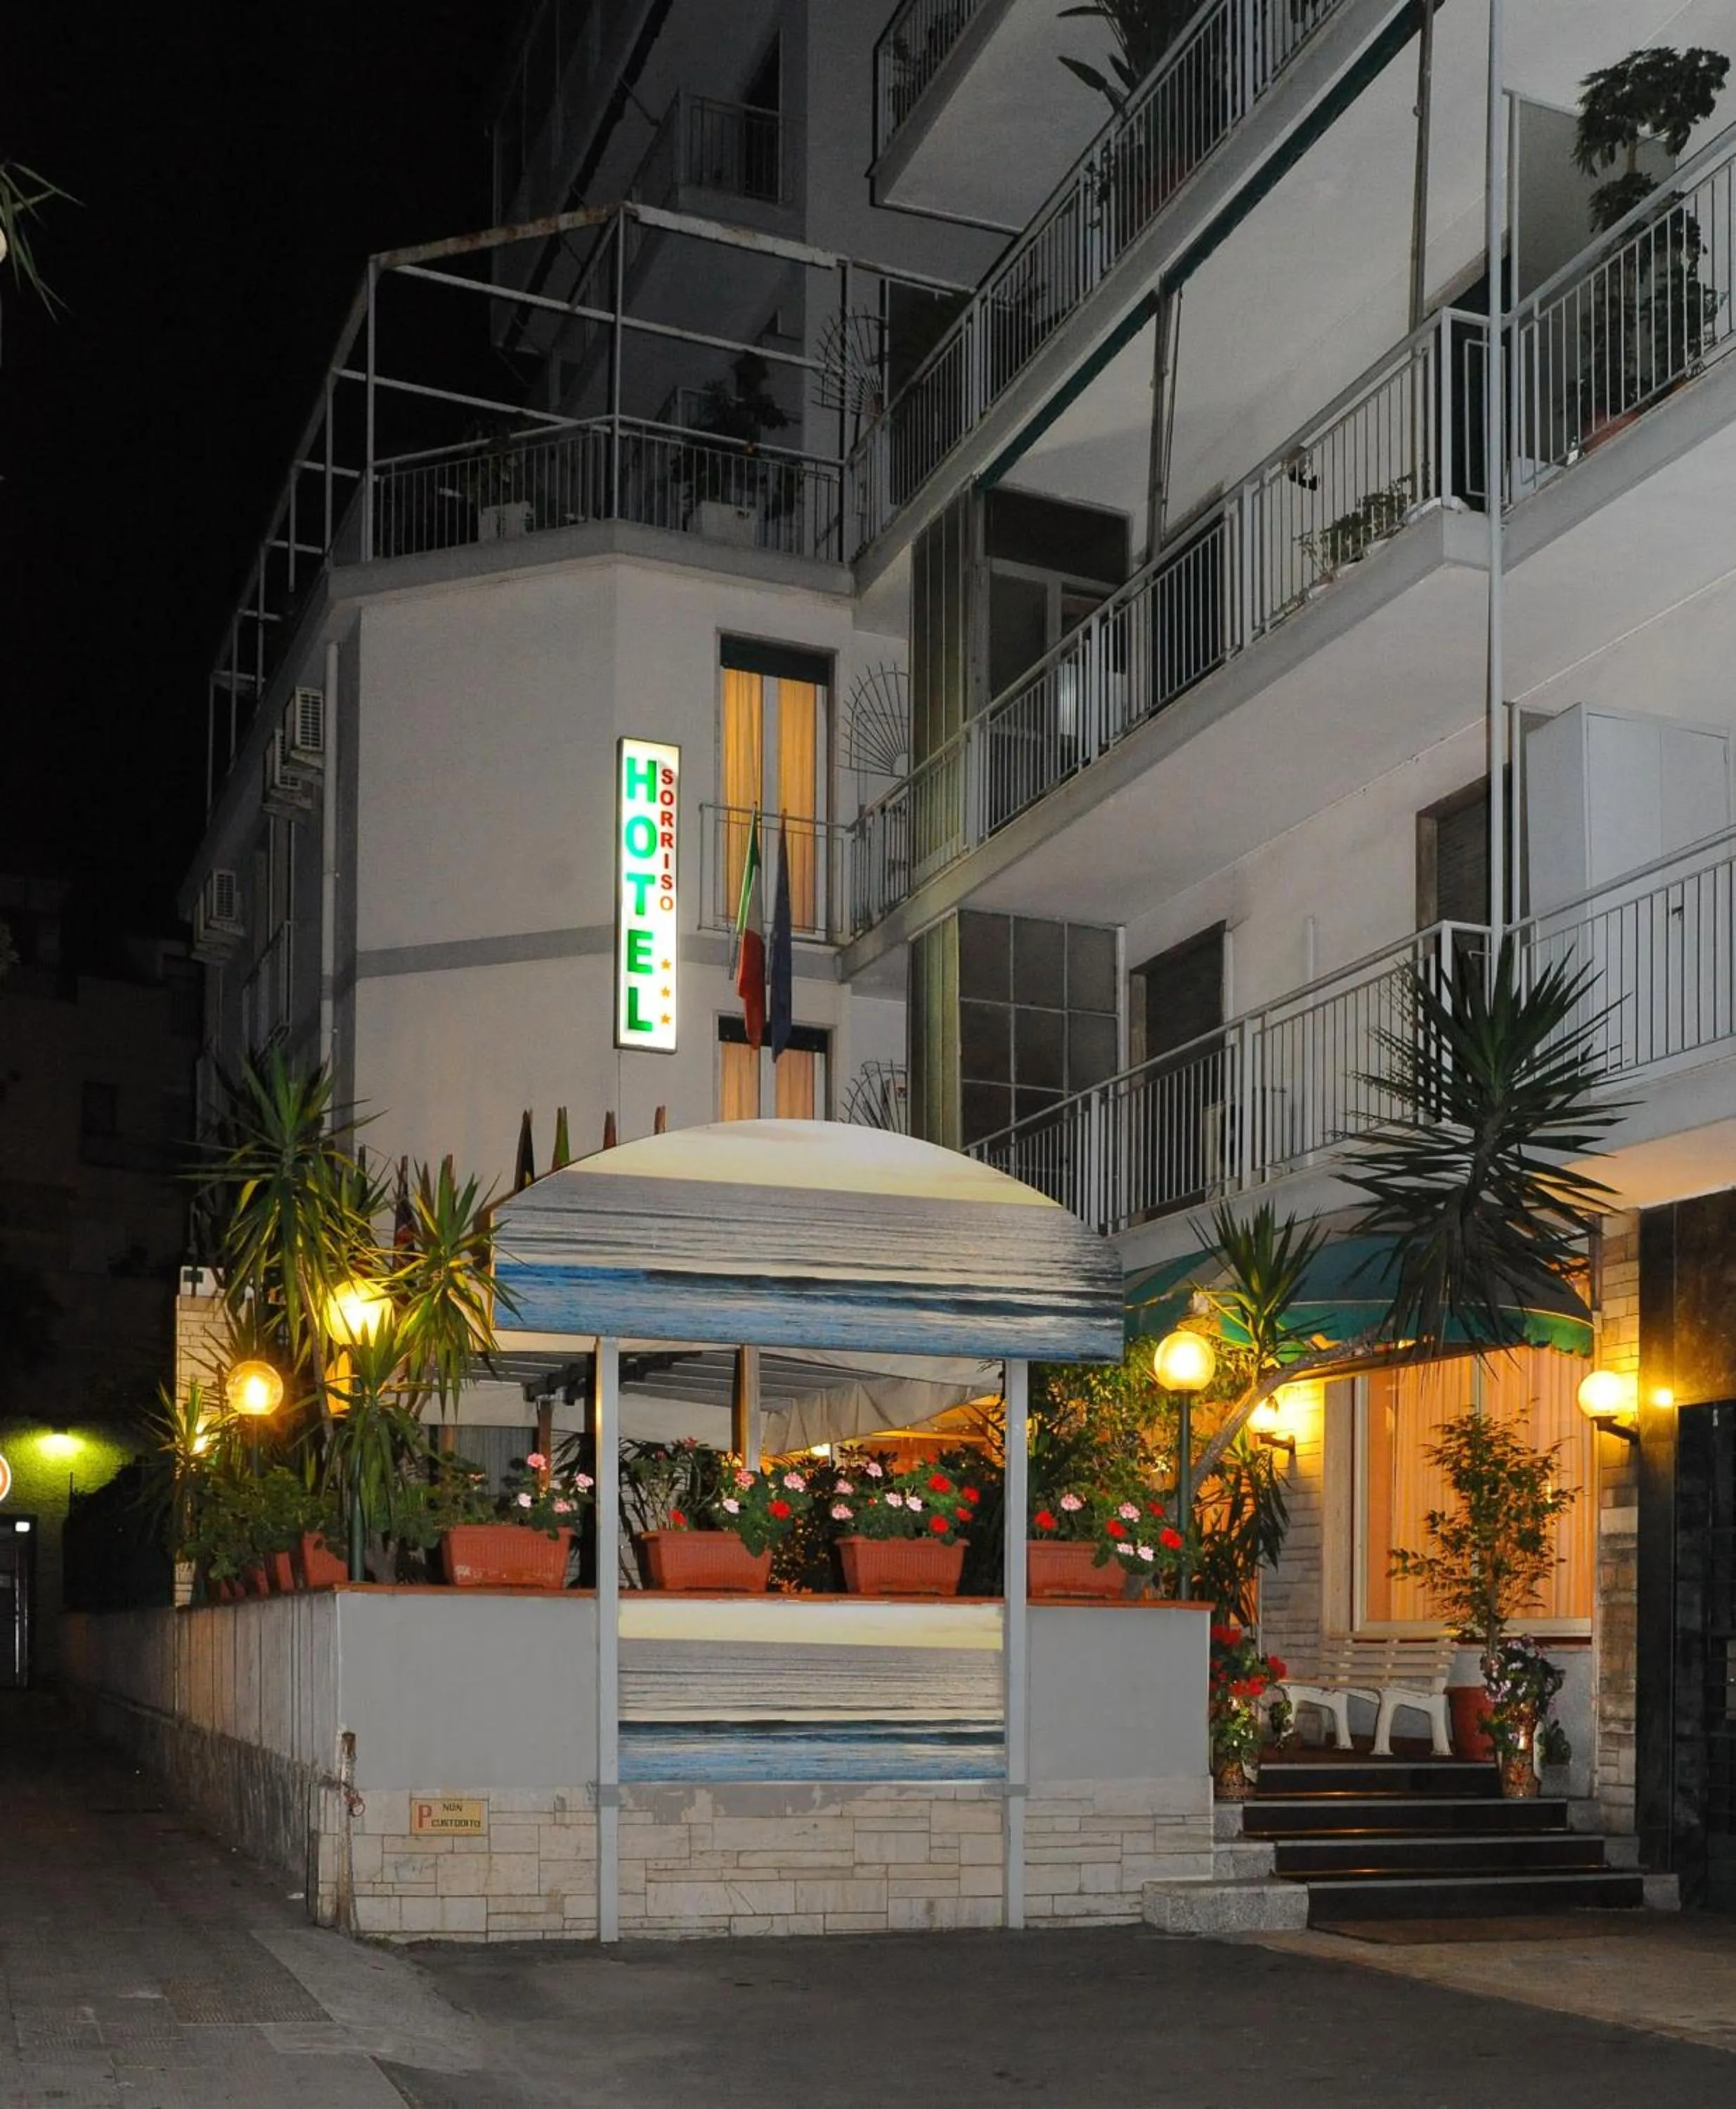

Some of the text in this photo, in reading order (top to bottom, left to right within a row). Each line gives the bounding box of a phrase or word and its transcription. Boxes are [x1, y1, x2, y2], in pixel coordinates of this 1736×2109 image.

[625, 757, 658, 1033] HOTEL
[659, 768, 675, 912] SORRISO
[418, 1805, 432, 1828] P
